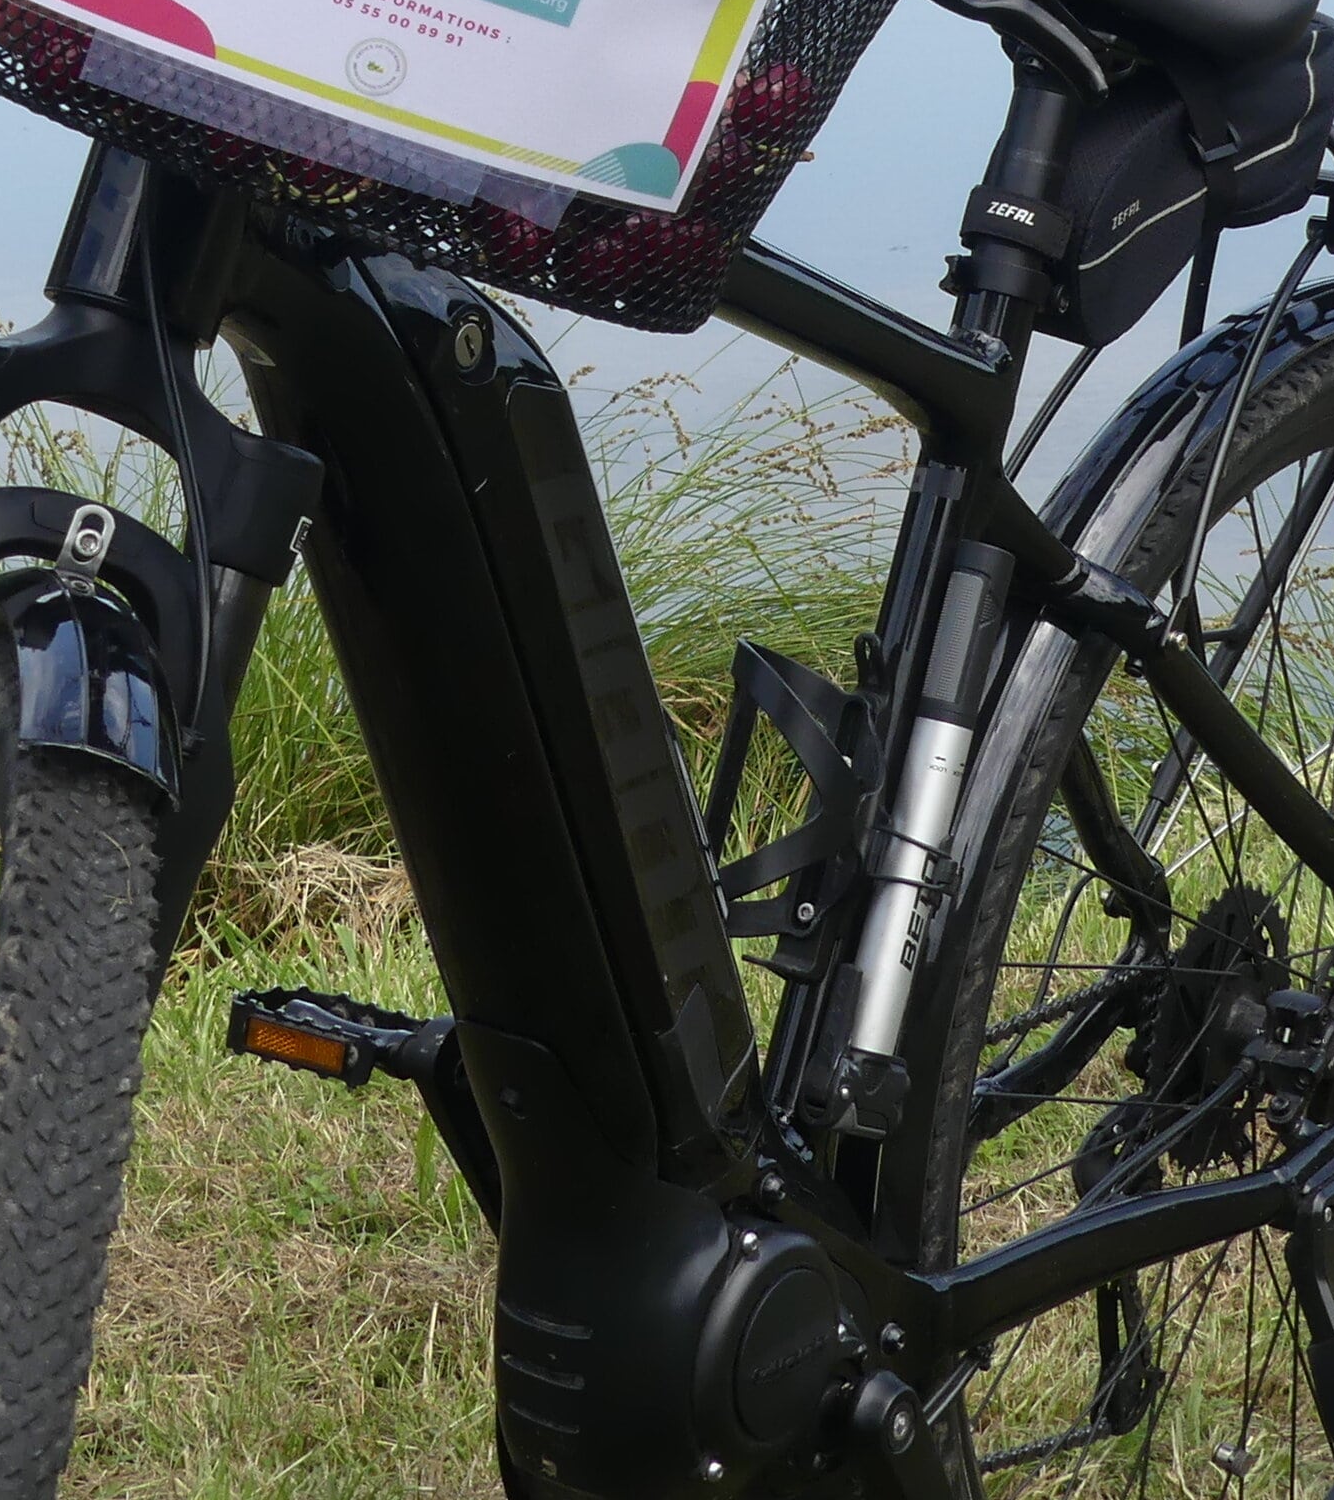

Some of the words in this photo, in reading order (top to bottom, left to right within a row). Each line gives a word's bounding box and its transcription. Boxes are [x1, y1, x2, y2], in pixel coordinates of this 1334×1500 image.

[359, 3, 381, 19] 55
[388, 13, 410, 29] 00
[417, 23, 439, 38] 89
[445, 33, 464, 47] 91
